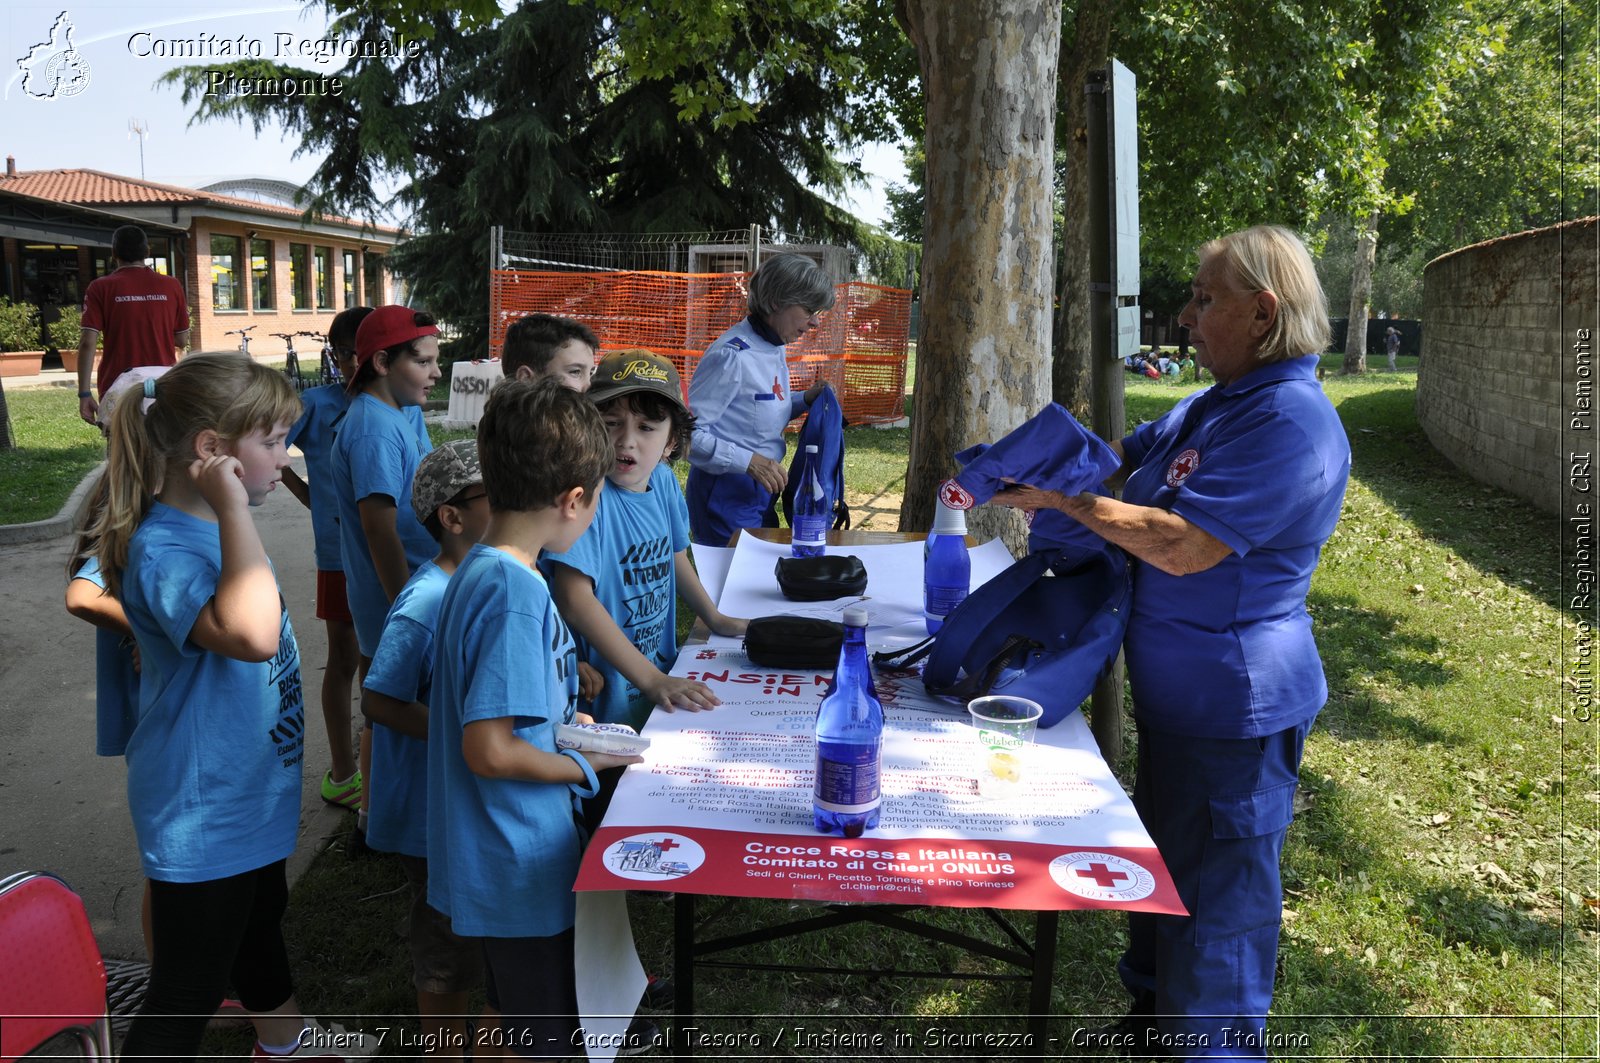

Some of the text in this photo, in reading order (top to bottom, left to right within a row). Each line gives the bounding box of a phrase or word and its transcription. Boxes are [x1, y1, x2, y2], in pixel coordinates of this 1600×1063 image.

[147, 294, 168, 302] ITALIANA
[623, 560, 670, 587] ATTENZION
[277, 669, 301, 697] RISC
[279, 687, 302, 715] CONT
[711, 735, 788, 743] termineranno
[725, 730, 787, 739] inizieranno
[978, 729, 1024, 748] Carlsberg
[665, 769, 701, 777] Croce
[673, 764, 711, 773] caccia
[661, 784, 717, 792] L'iniziativa
[764, 781, 814, 789] amicizia
[753, 794, 775, 802] San
[778, 796, 814, 804] Giaco
[689, 798, 723, 806] Croce
[727, 800, 762, 808] Rossa
[886, 806, 919, 815] Chieri
[1019, 812, 1081, 821] proseguire
[722, 807, 776, 817] cammino
[958, 817, 1019, 826] attraverso
[1022, 818, 1030, 826] il
[1033, 819, 1065, 827] gioco
[744, 842, 1012, 861] Croce Rossa Italiana
[743, 855, 1016, 875] Comitato di Chieri ONLUS
[746, 869, 772, 878] Sedi
[774, 870, 785, 879] di
[788, 871, 824, 881] Chieri,
[828, 873, 872, 882] Pecetto
[876, 875, 924, 885] Torinese
[938, 878, 963, 887] Pino
[966, 879, 1015, 889] Torinese
[839, 882, 922, 894] cl.chieri@cri.it
